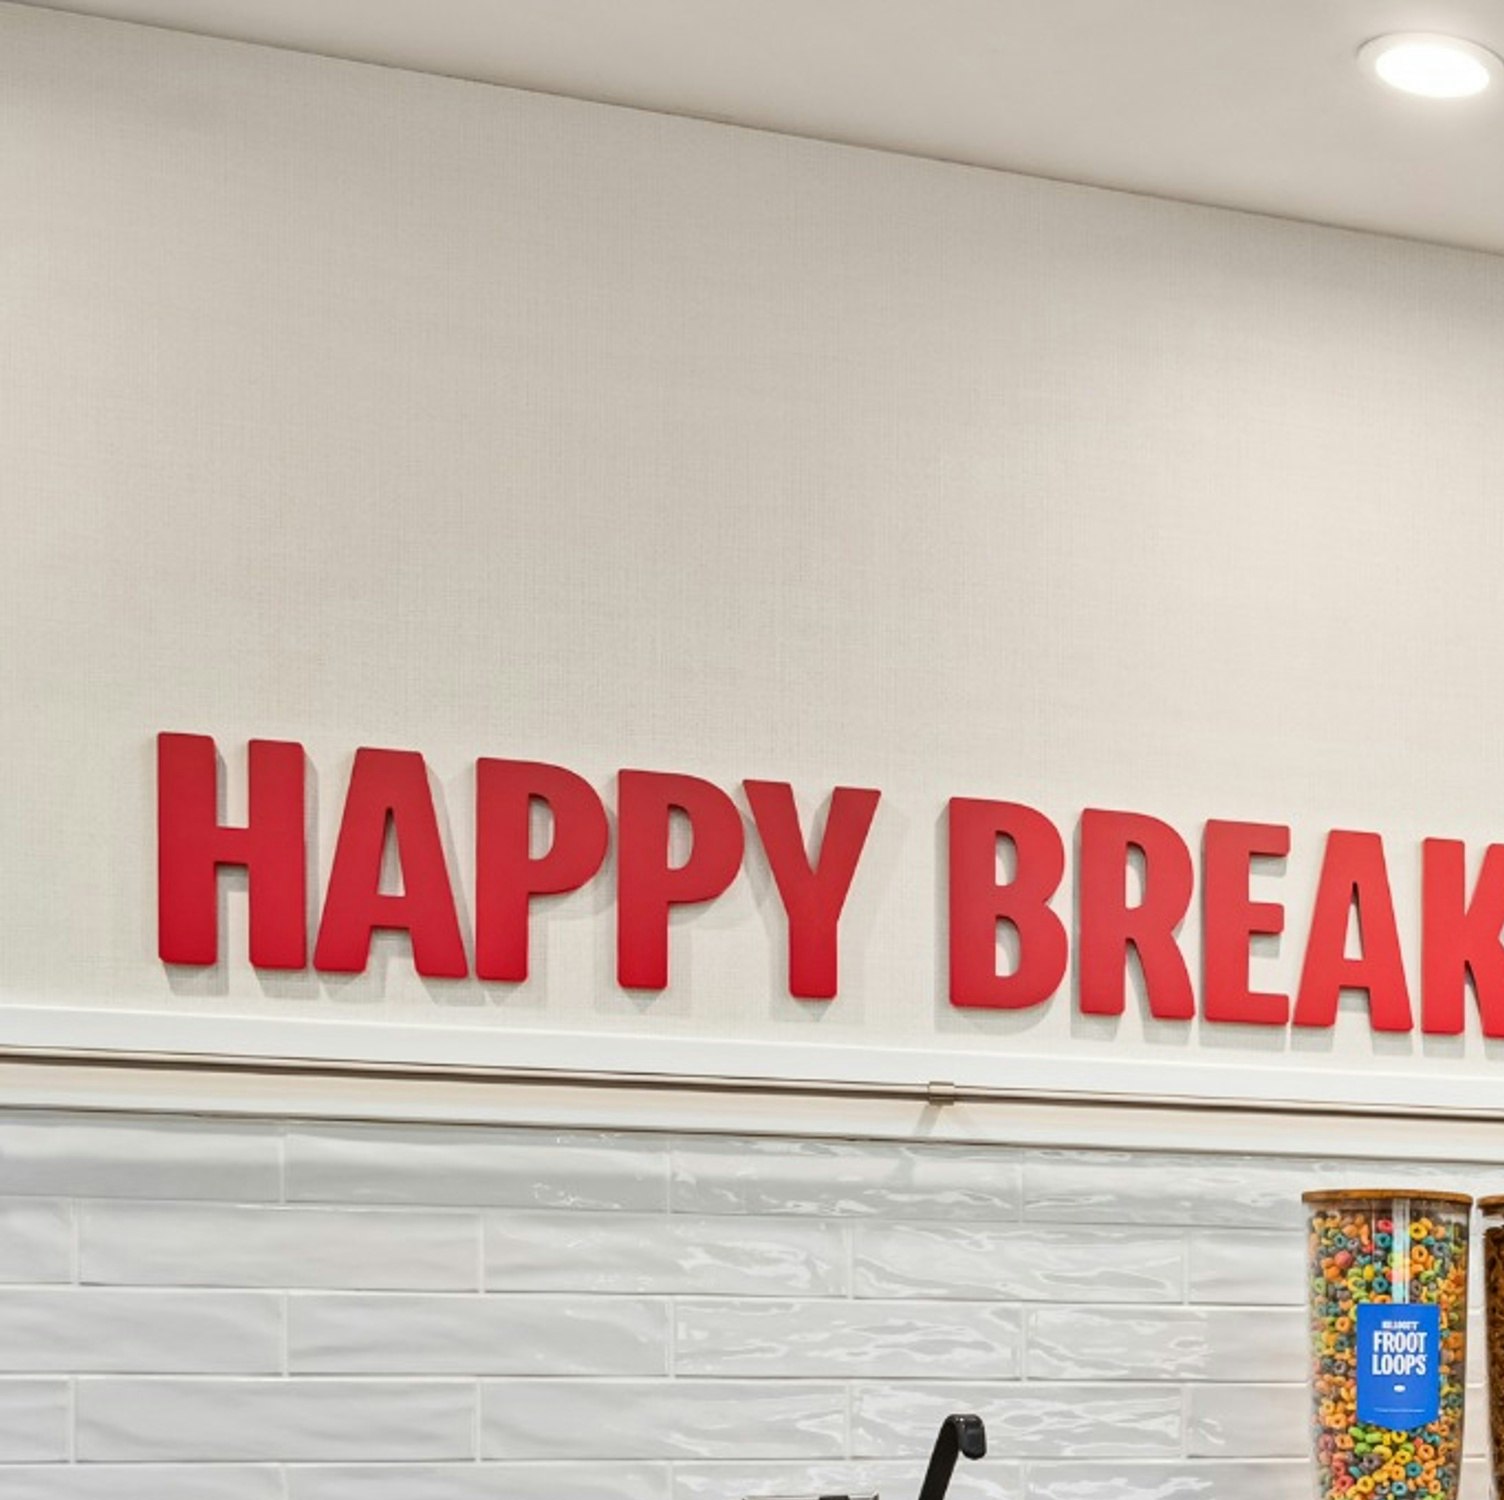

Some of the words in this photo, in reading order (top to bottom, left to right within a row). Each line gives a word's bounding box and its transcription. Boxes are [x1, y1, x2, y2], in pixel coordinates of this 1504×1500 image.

[158, 733, 881, 1001] HAPPY
[1373, 1330, 1427, 1353] FROOT
[1372, 1354, 1427, 1375] LOOPS
